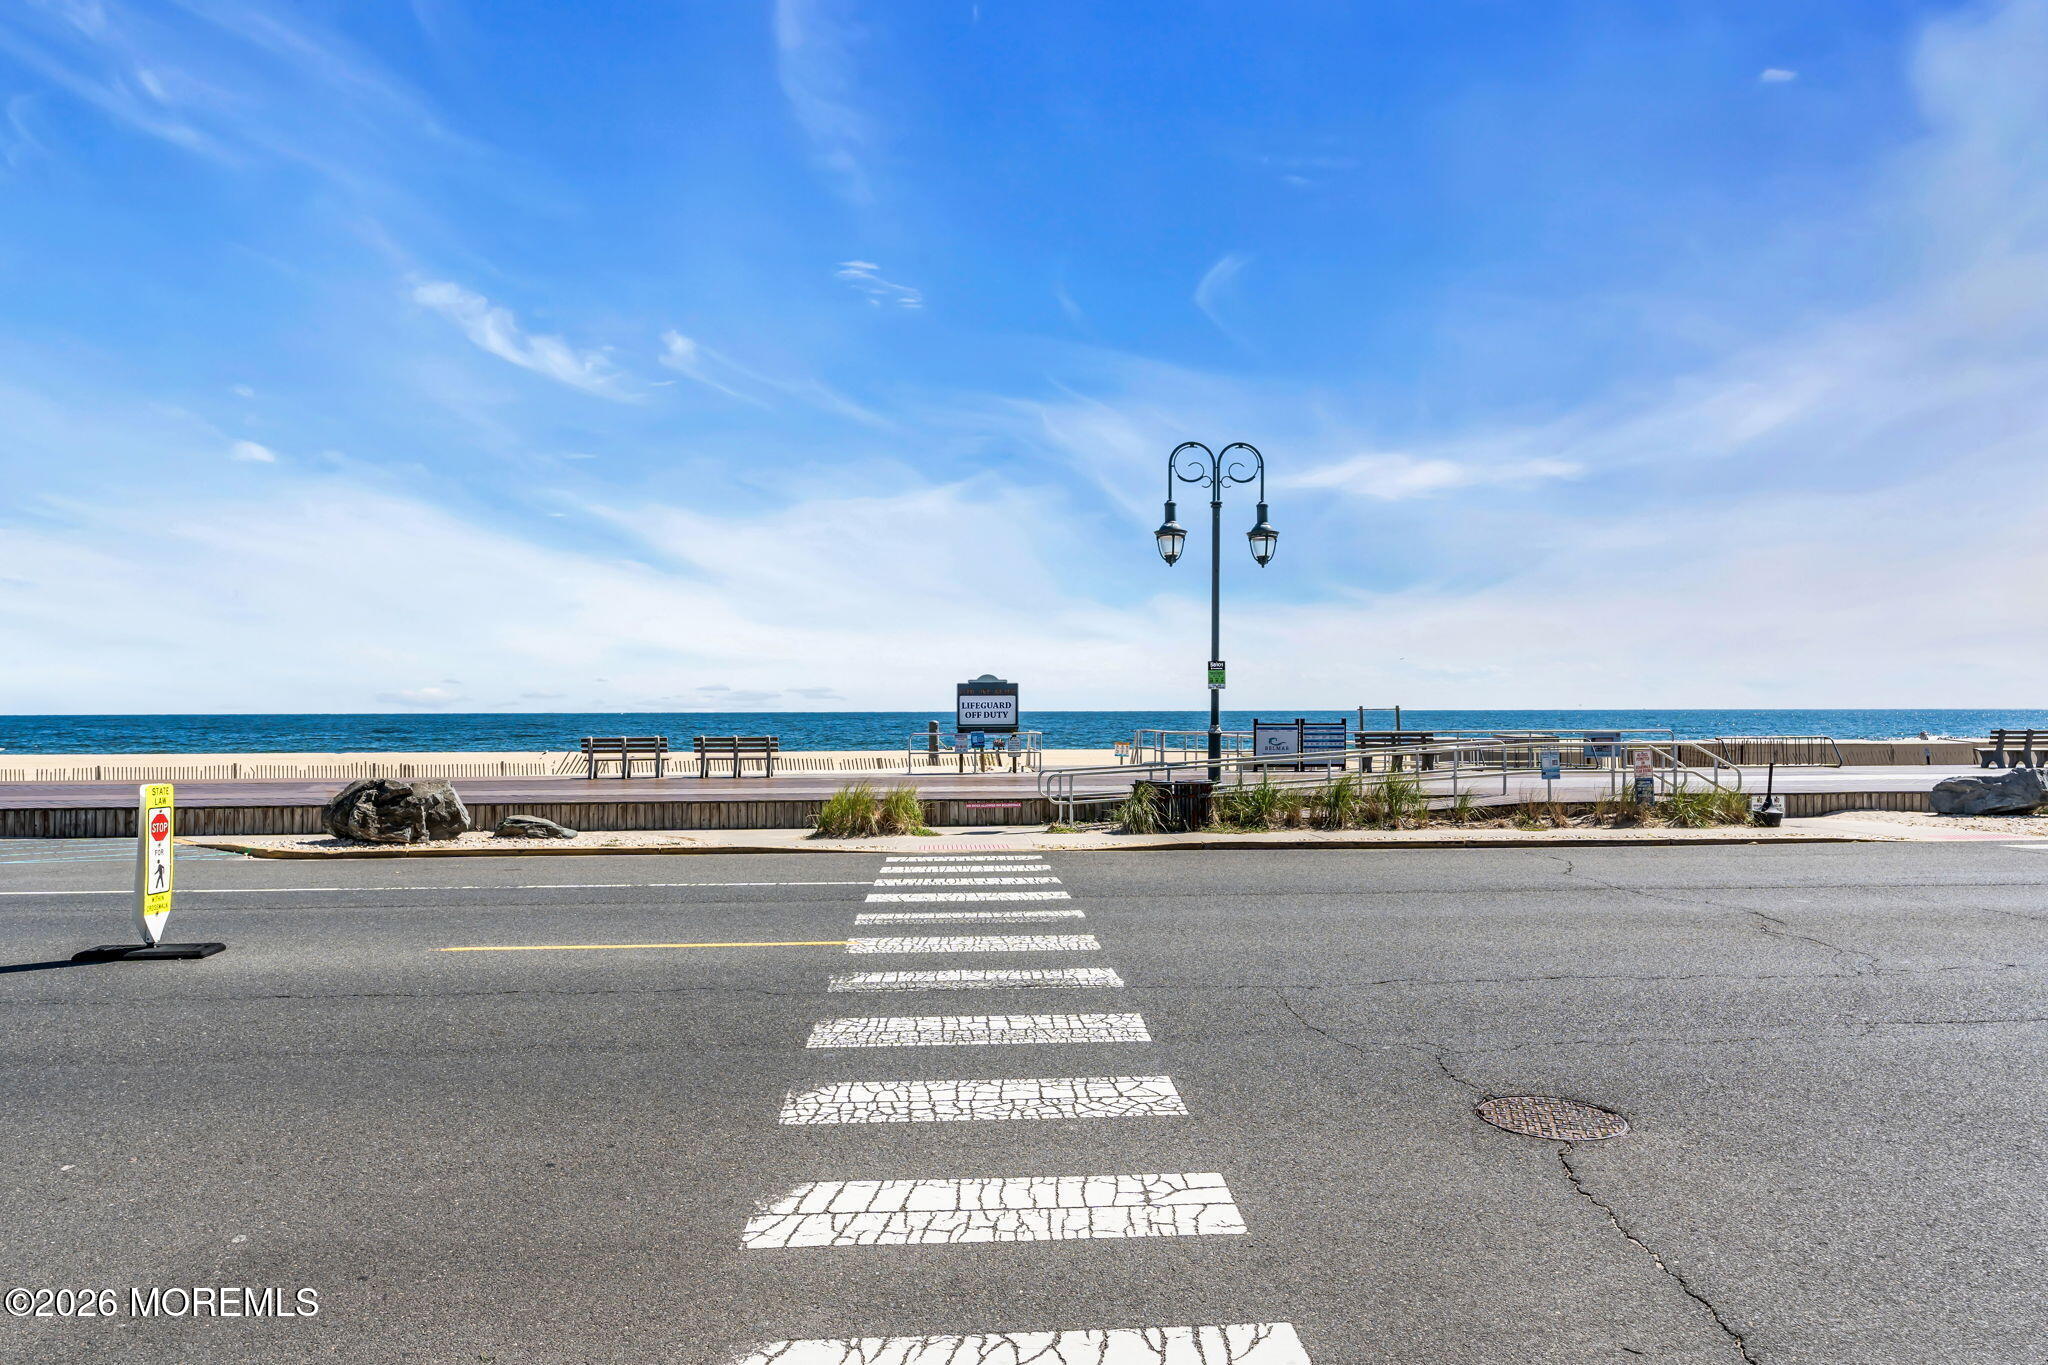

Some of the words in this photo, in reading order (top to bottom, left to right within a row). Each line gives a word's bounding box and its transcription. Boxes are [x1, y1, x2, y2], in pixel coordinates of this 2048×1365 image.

[965, 711, 982, 719] OFF
[983, 711, 1009, 719] DUTY
[152, 787, 169, 796] STATE
[151, 822, 168, 832] STOP
